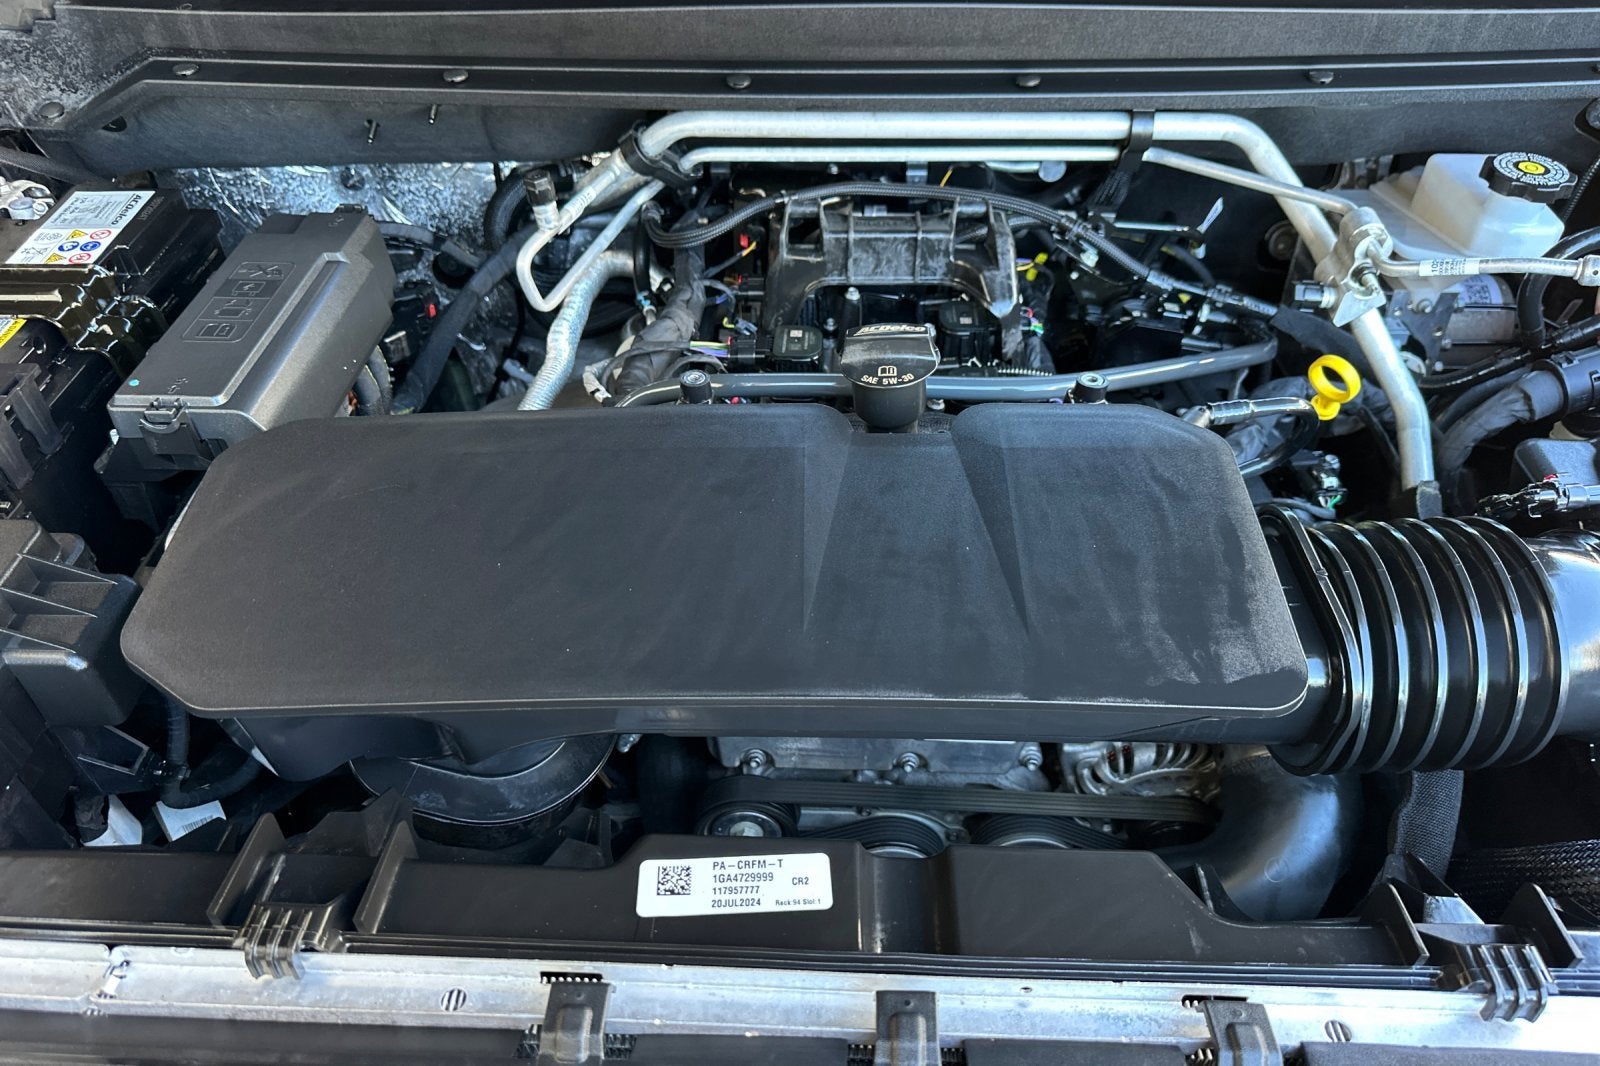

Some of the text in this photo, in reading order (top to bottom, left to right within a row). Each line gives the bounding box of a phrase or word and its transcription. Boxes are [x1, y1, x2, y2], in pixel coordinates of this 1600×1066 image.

[111, 194, 142, 225] ACDelco
[854, 325, 926, 336] ACDelco
[861, 373, 915, 385] SAE 5W-30
[713, 872, 774, 884] 1GA4729999
[791, 876, 809, 886] CR2
[712, 885, 760, 895] 117957777
[711, 898, 761, 908] 20JUL2024
